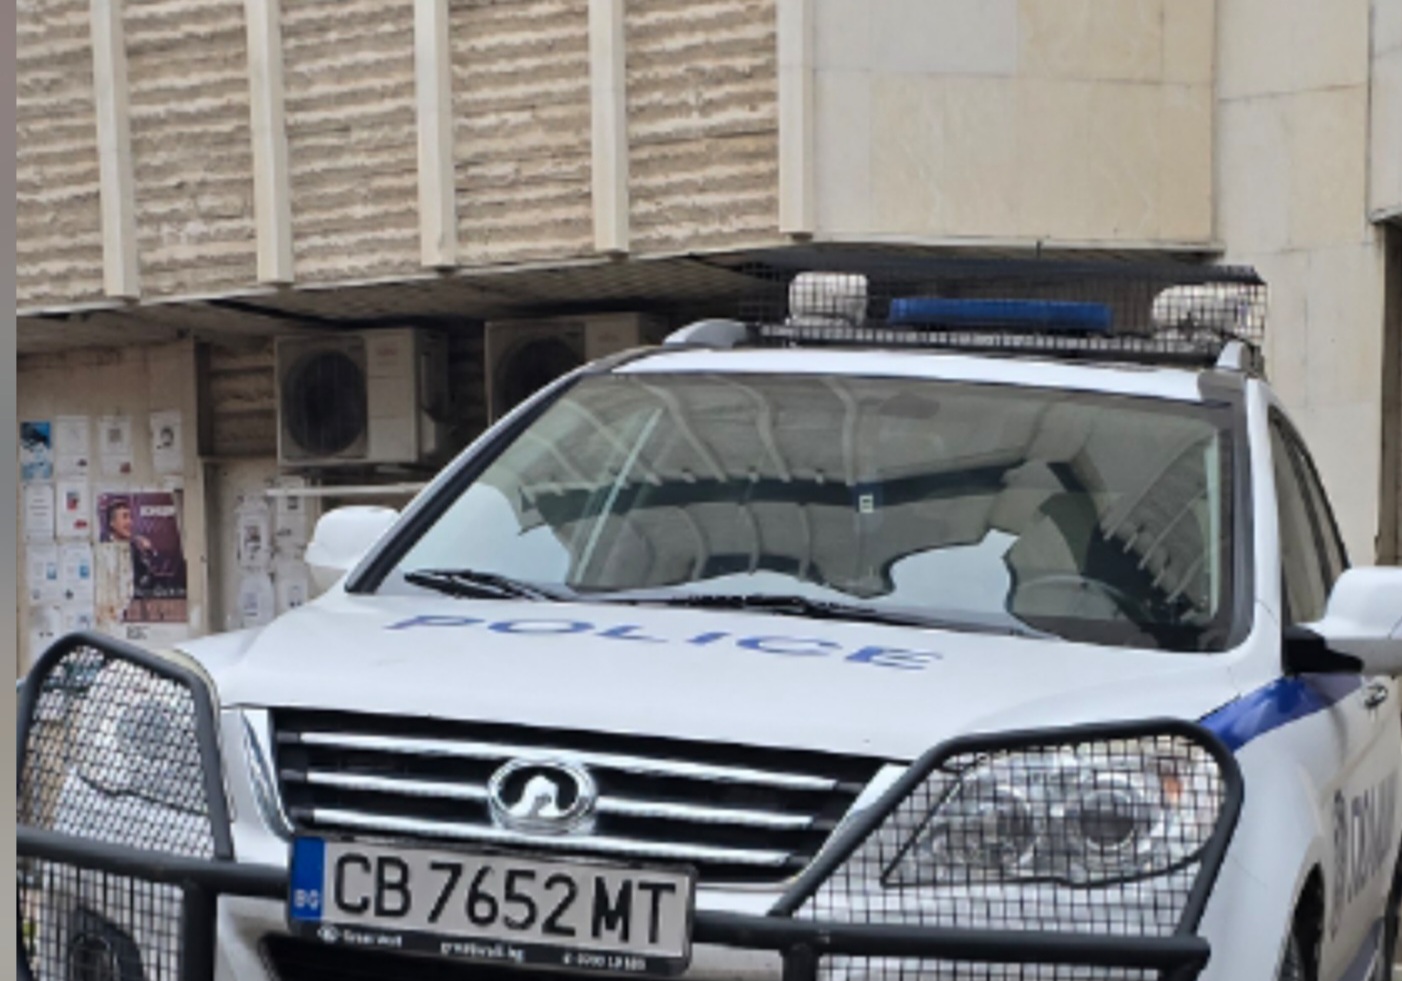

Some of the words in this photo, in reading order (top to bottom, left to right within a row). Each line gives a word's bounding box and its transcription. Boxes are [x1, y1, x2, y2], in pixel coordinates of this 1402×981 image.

[386, 614, 943, 671] POLICE
[427, 861, 578, 937] 7652
[591, 875, 676, 944] MT
